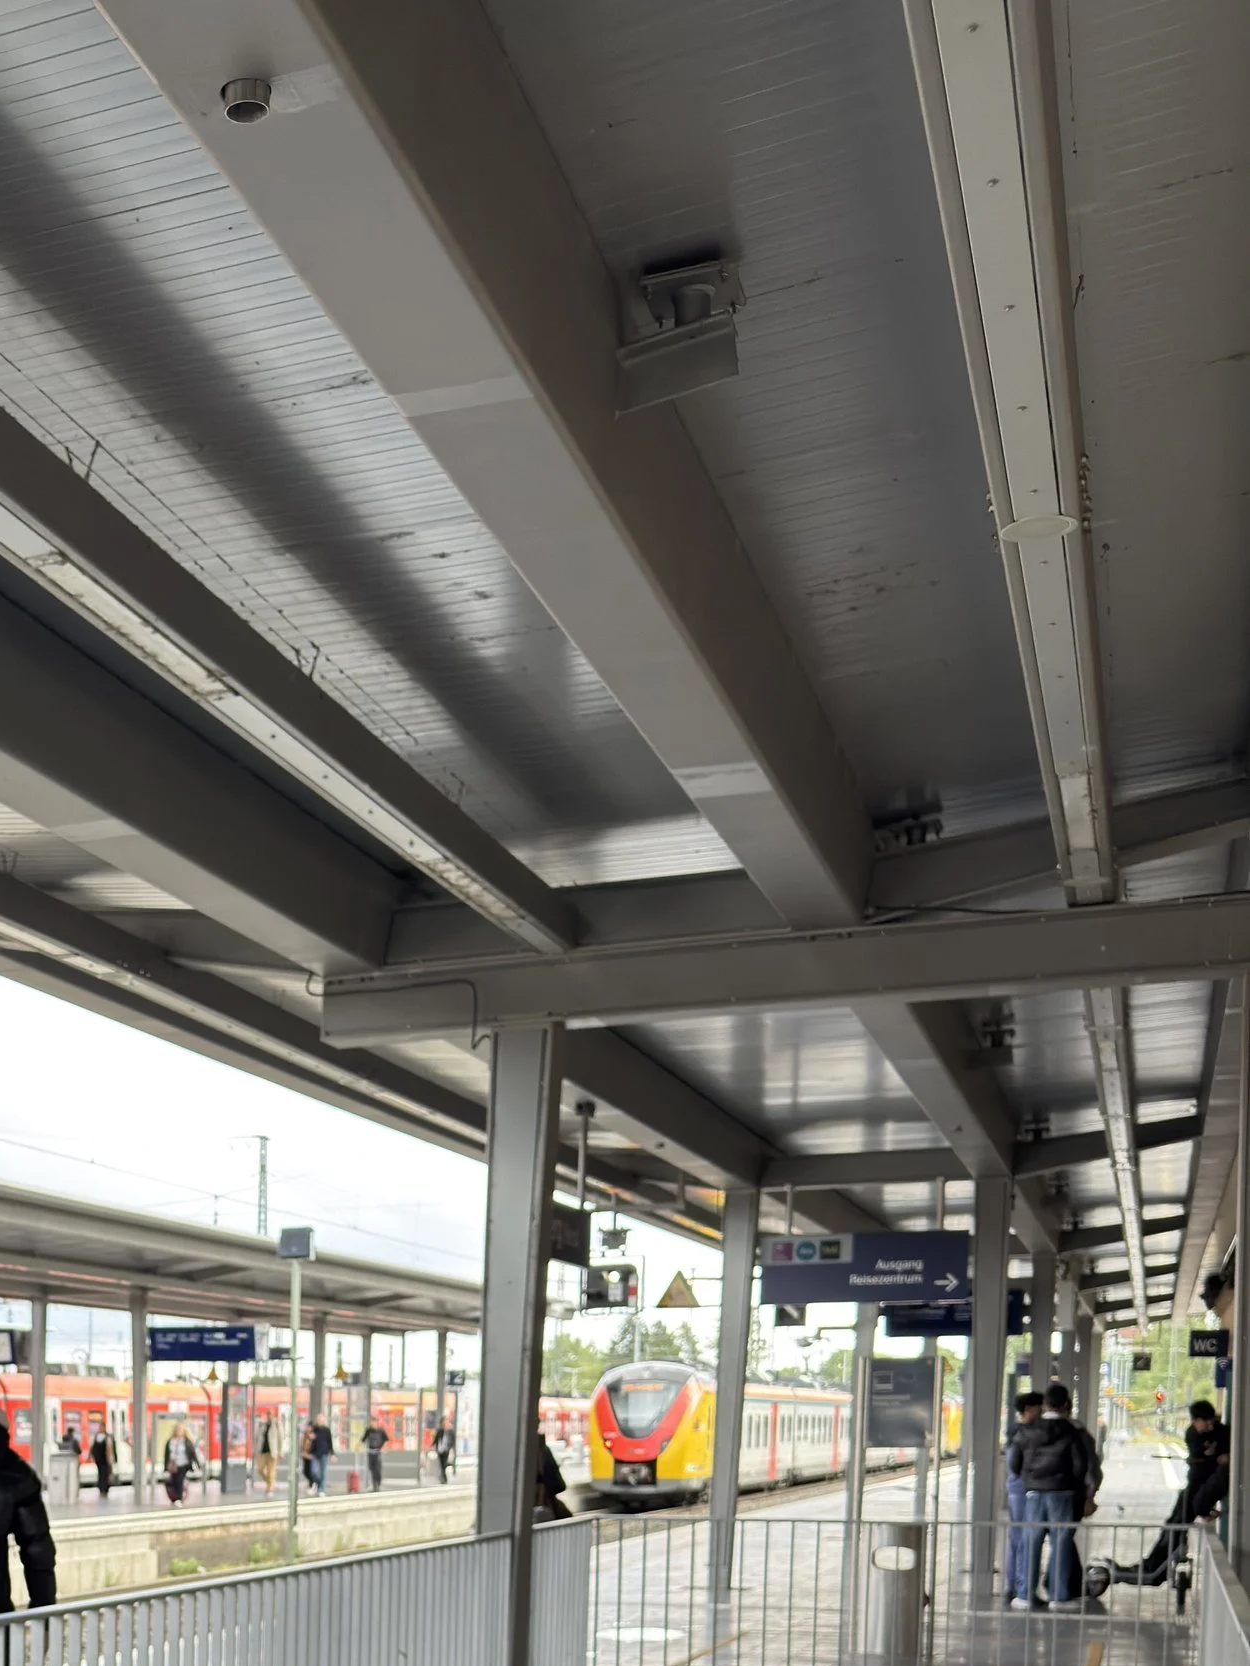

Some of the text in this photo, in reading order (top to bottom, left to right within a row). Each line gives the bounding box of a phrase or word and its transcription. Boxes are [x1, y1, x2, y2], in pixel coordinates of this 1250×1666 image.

[875, 1260, 924, 1272] Ausgang
[849, 1272, 923, 1286] Reisezentrum
[1193, 1338, 1218, 1354] WC
